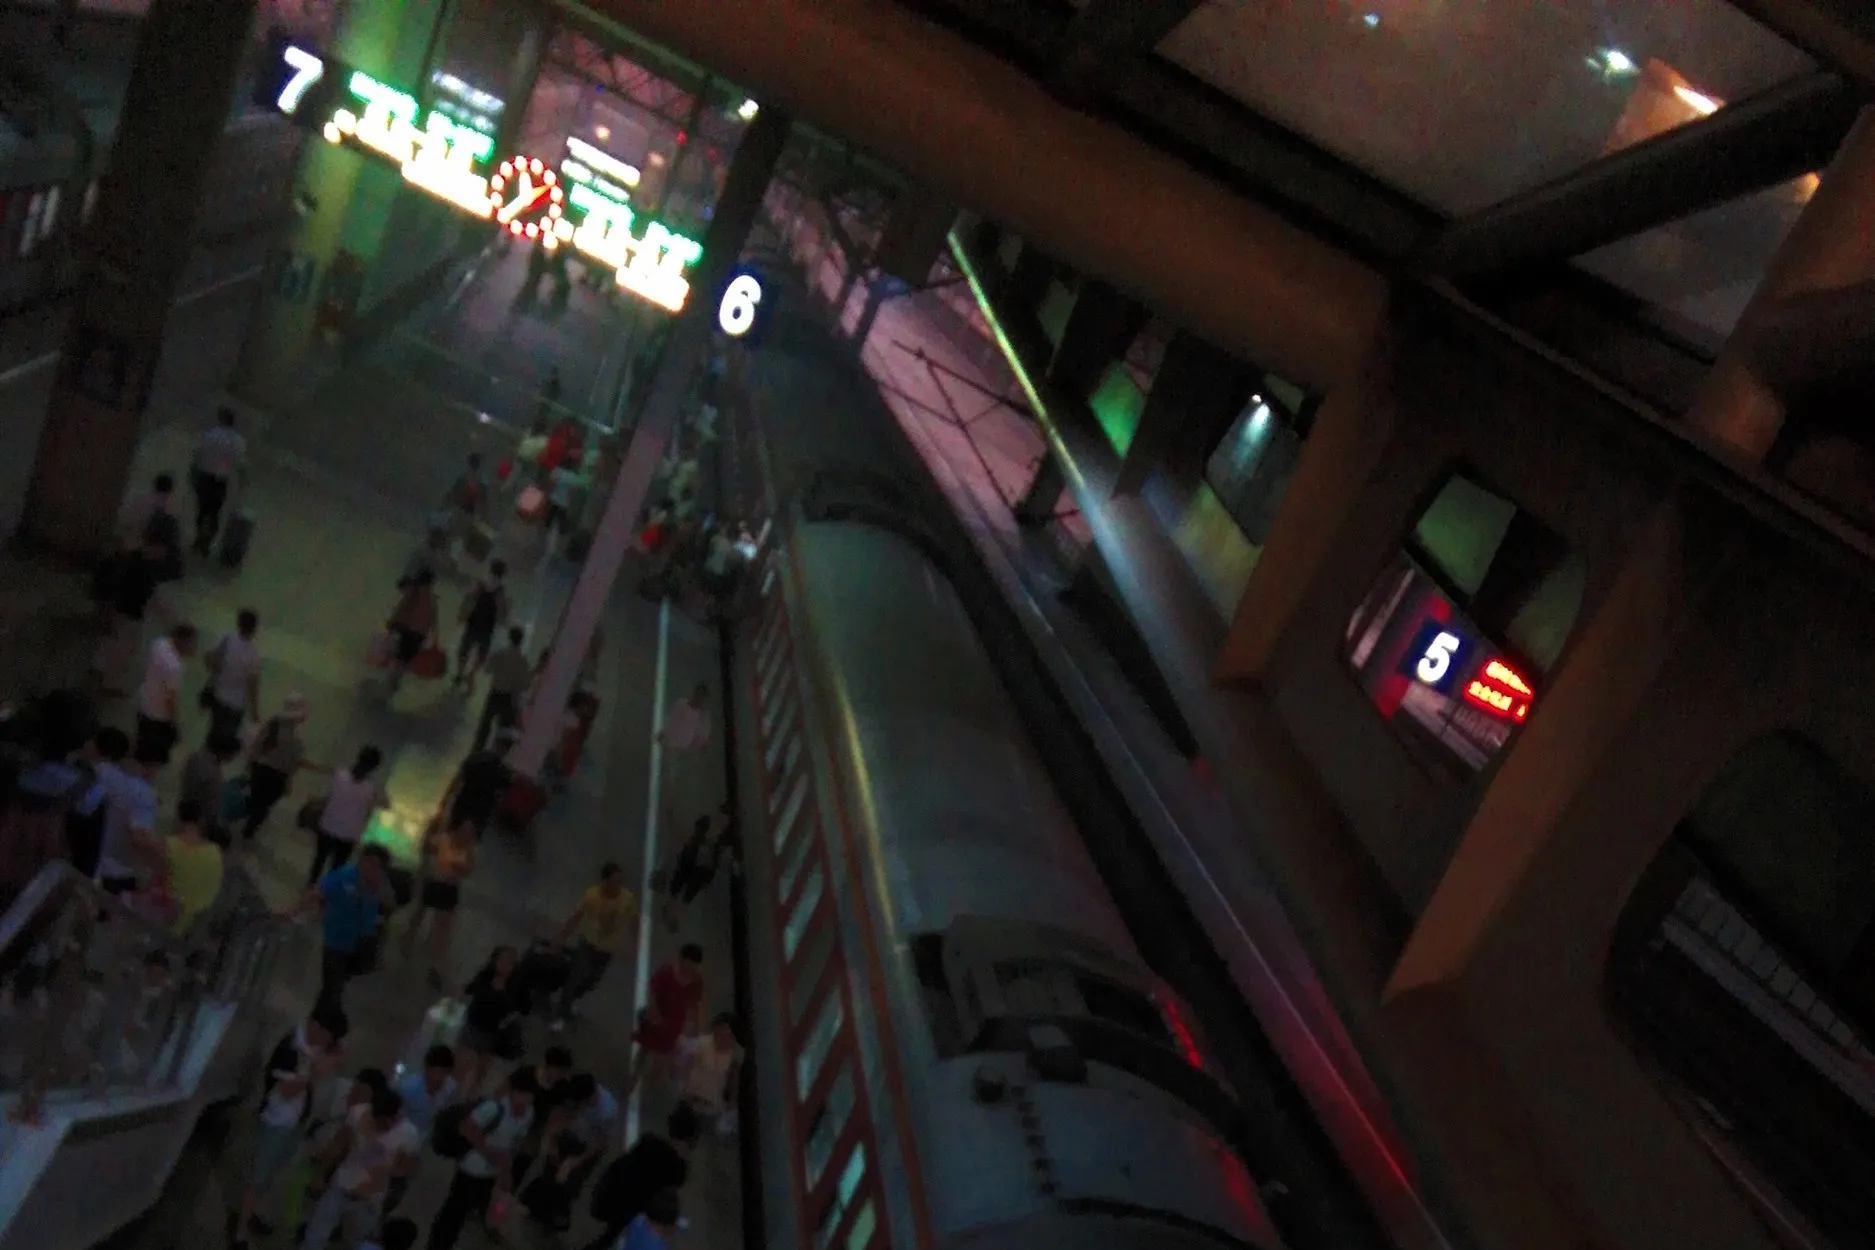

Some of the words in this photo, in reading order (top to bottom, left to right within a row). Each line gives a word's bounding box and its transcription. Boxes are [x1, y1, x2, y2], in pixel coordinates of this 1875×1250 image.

[277, 45, 324, 114] 7
[718, 274, 762, 337] 6
[1416, 631, 1460, 684] 5
